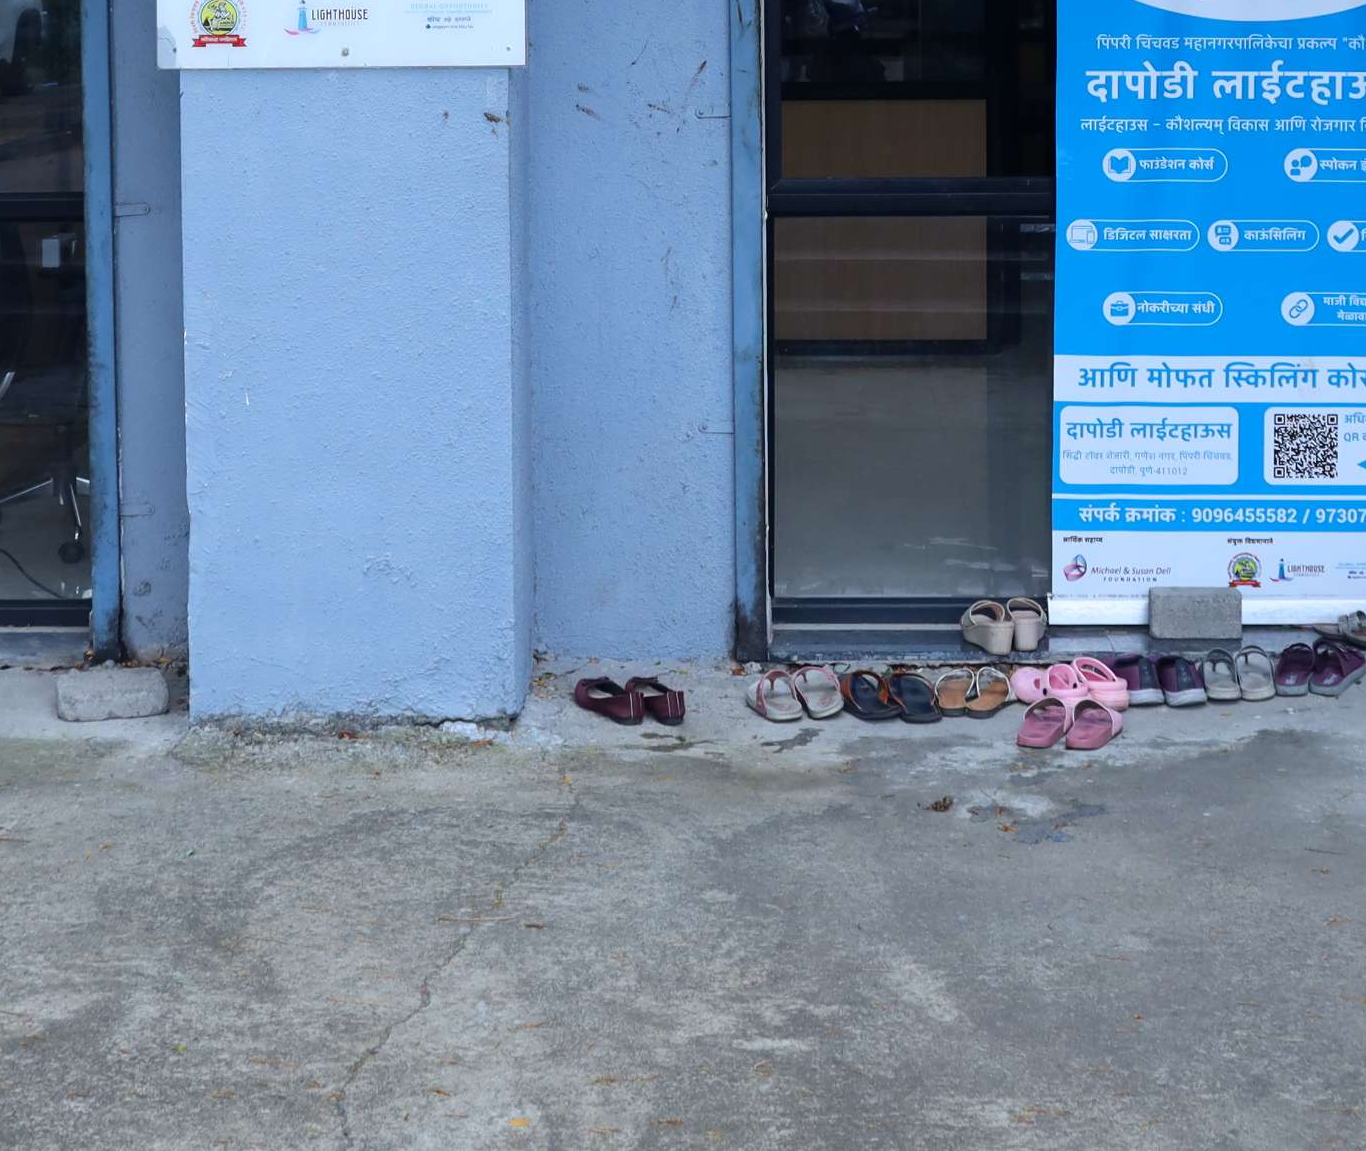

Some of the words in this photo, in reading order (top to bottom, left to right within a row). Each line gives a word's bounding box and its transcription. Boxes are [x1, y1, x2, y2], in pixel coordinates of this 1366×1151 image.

[312, 9, 368, 20] LIGHTHOUSE
[1096, 34, 1132, 49] पिंपरी
[1135, 34, 1180, 50] चिंचवड
[1183, 34, 1294, 51] महानगरपालिकेचा
[1297, 38, 1337, 50] प्रकल्प
[1086, 61, 1198, 103] दापोडी
[1165, 114, 1226, 135] कौशल्यम्
[1227, 116, 1269, 131] विकास
[1275, 114, 1307, 131] आणि
[1310, 116, 1356, 132] रोजगार
[1139, 156, 1188, 170] फाउंडेशन
[1189, 156, 1214, 169] कोर्स
[1319, 157, 1358, 170] स्पोकन
[1104, 227, 1147, 240] डिजिटल
[1149, 230, 1192, 240] साक्षरता
[1136, 300, 1191, 313] नोकरीच्या
[1192, 301, 1215, 313] संधी
[1078, 362, 1138, 388] आणि
[1147, 362, 1215, 388] मोफत
[1223, 362, 1319, 388] स्किलिंग
[1066, 418, 1124, 440] दापोडी
[1130, 418, 1233, 442] लाईटहाऊस
[1344, 433, 1359, 442] QR
[1079, 502, 1121, 522] संपर्क
[1125, 505, 1176, 522] क्रमांक
[1192, 508, 1299, 523] 9096455582
[1091, 566, 1121, 574] Michael
[1123, 567, 1130, 575] &
[1132, 567, 1154, 576] Susan
[1156, 567, 1171, 575] Dell
